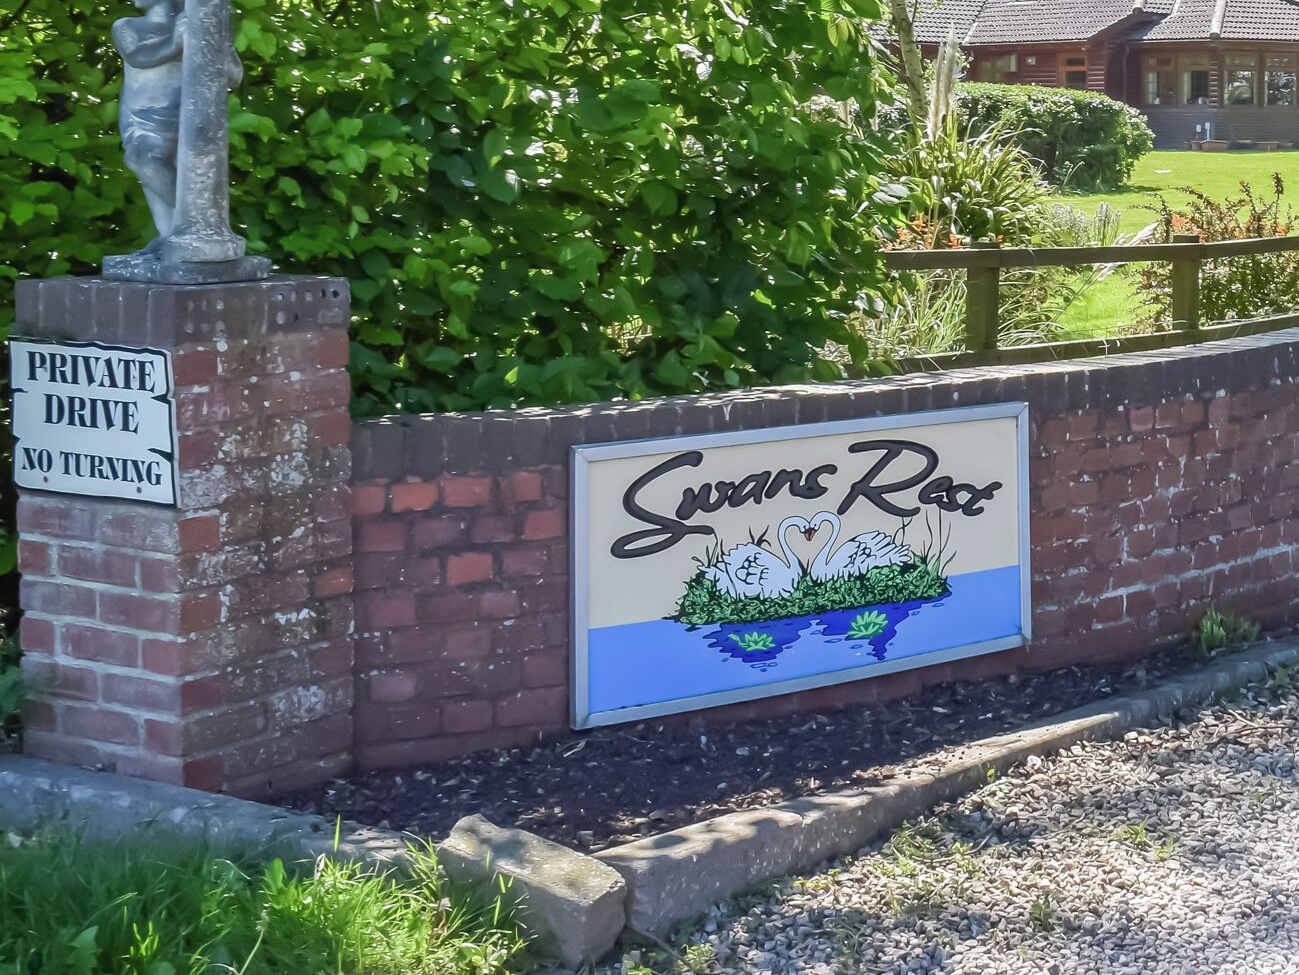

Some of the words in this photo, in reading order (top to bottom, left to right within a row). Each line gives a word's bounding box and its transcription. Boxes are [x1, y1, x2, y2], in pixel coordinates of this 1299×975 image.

[26, 350, 156, 393] PRIVATE
[43, 393, 139, 435] DRIVE
[21, 446, 53, 473] NO
[59, 450, 163, 486] TURNING
[610, 450, 838, 559] Swans
[837, 439, 1003, 517] Rest
